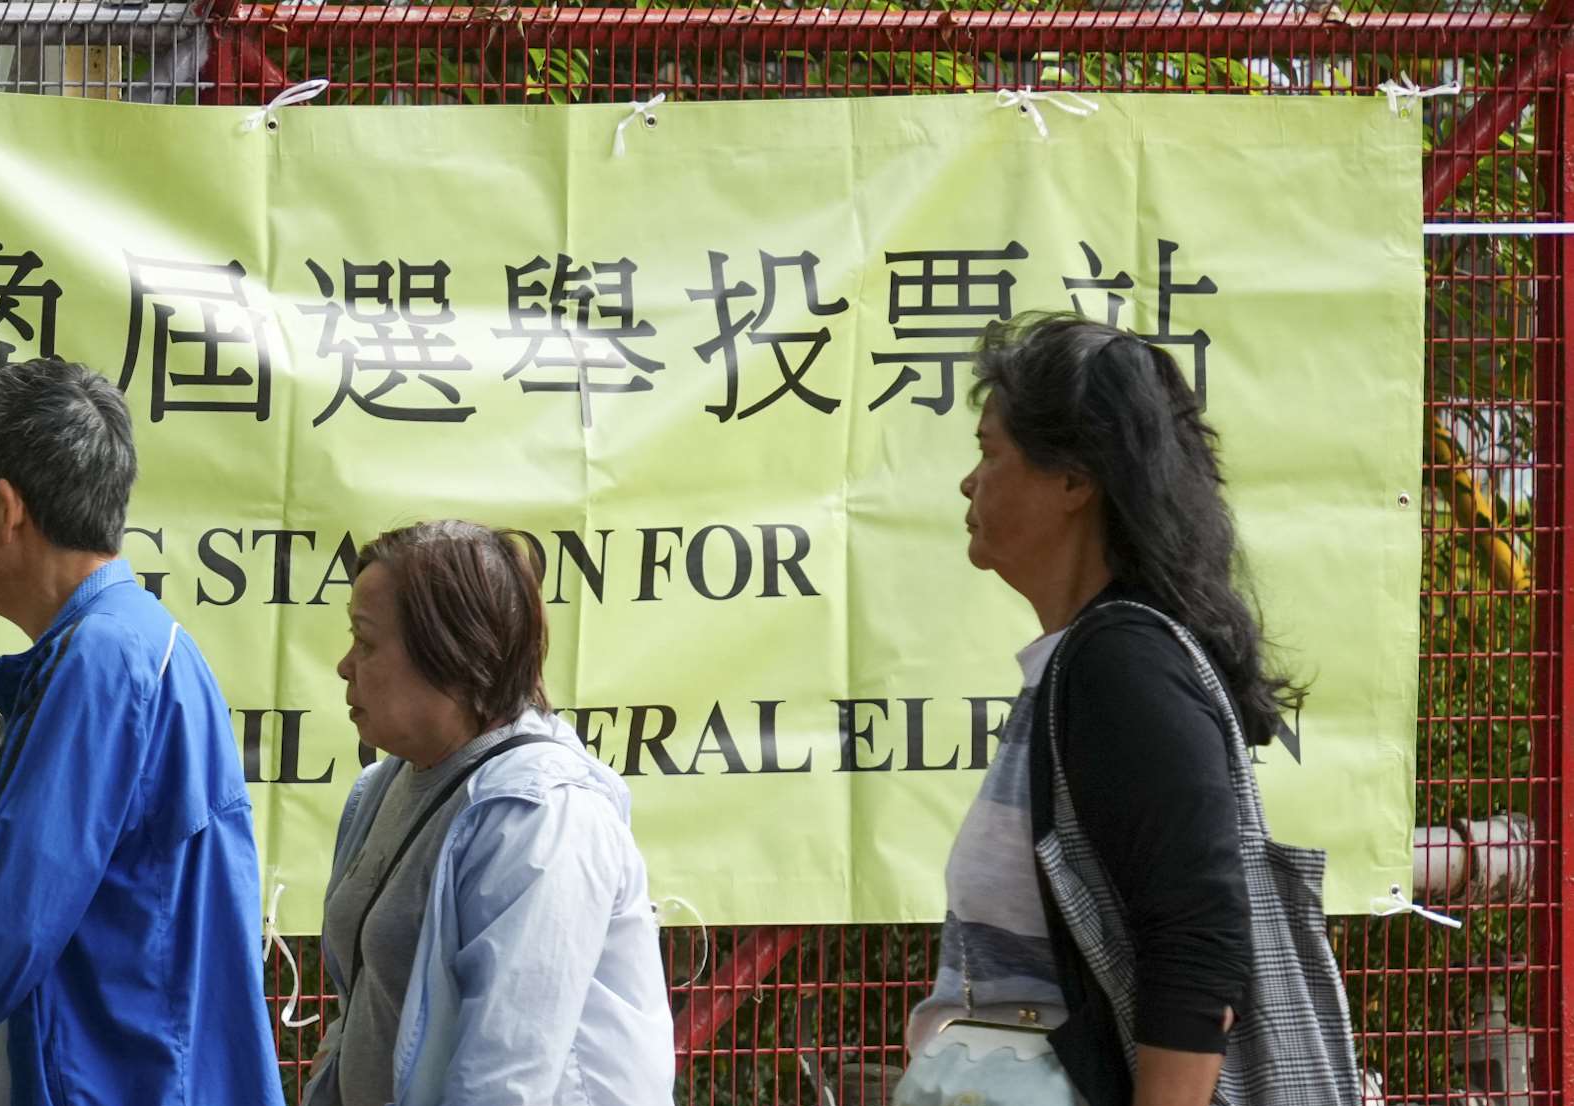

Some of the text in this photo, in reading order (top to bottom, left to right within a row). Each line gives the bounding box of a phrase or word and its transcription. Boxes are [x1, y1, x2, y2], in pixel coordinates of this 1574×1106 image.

[196, 526, 615, 606] STAN
[630, 524, 822, 602] FOR
[358, 697, 813, 777] ERAL
